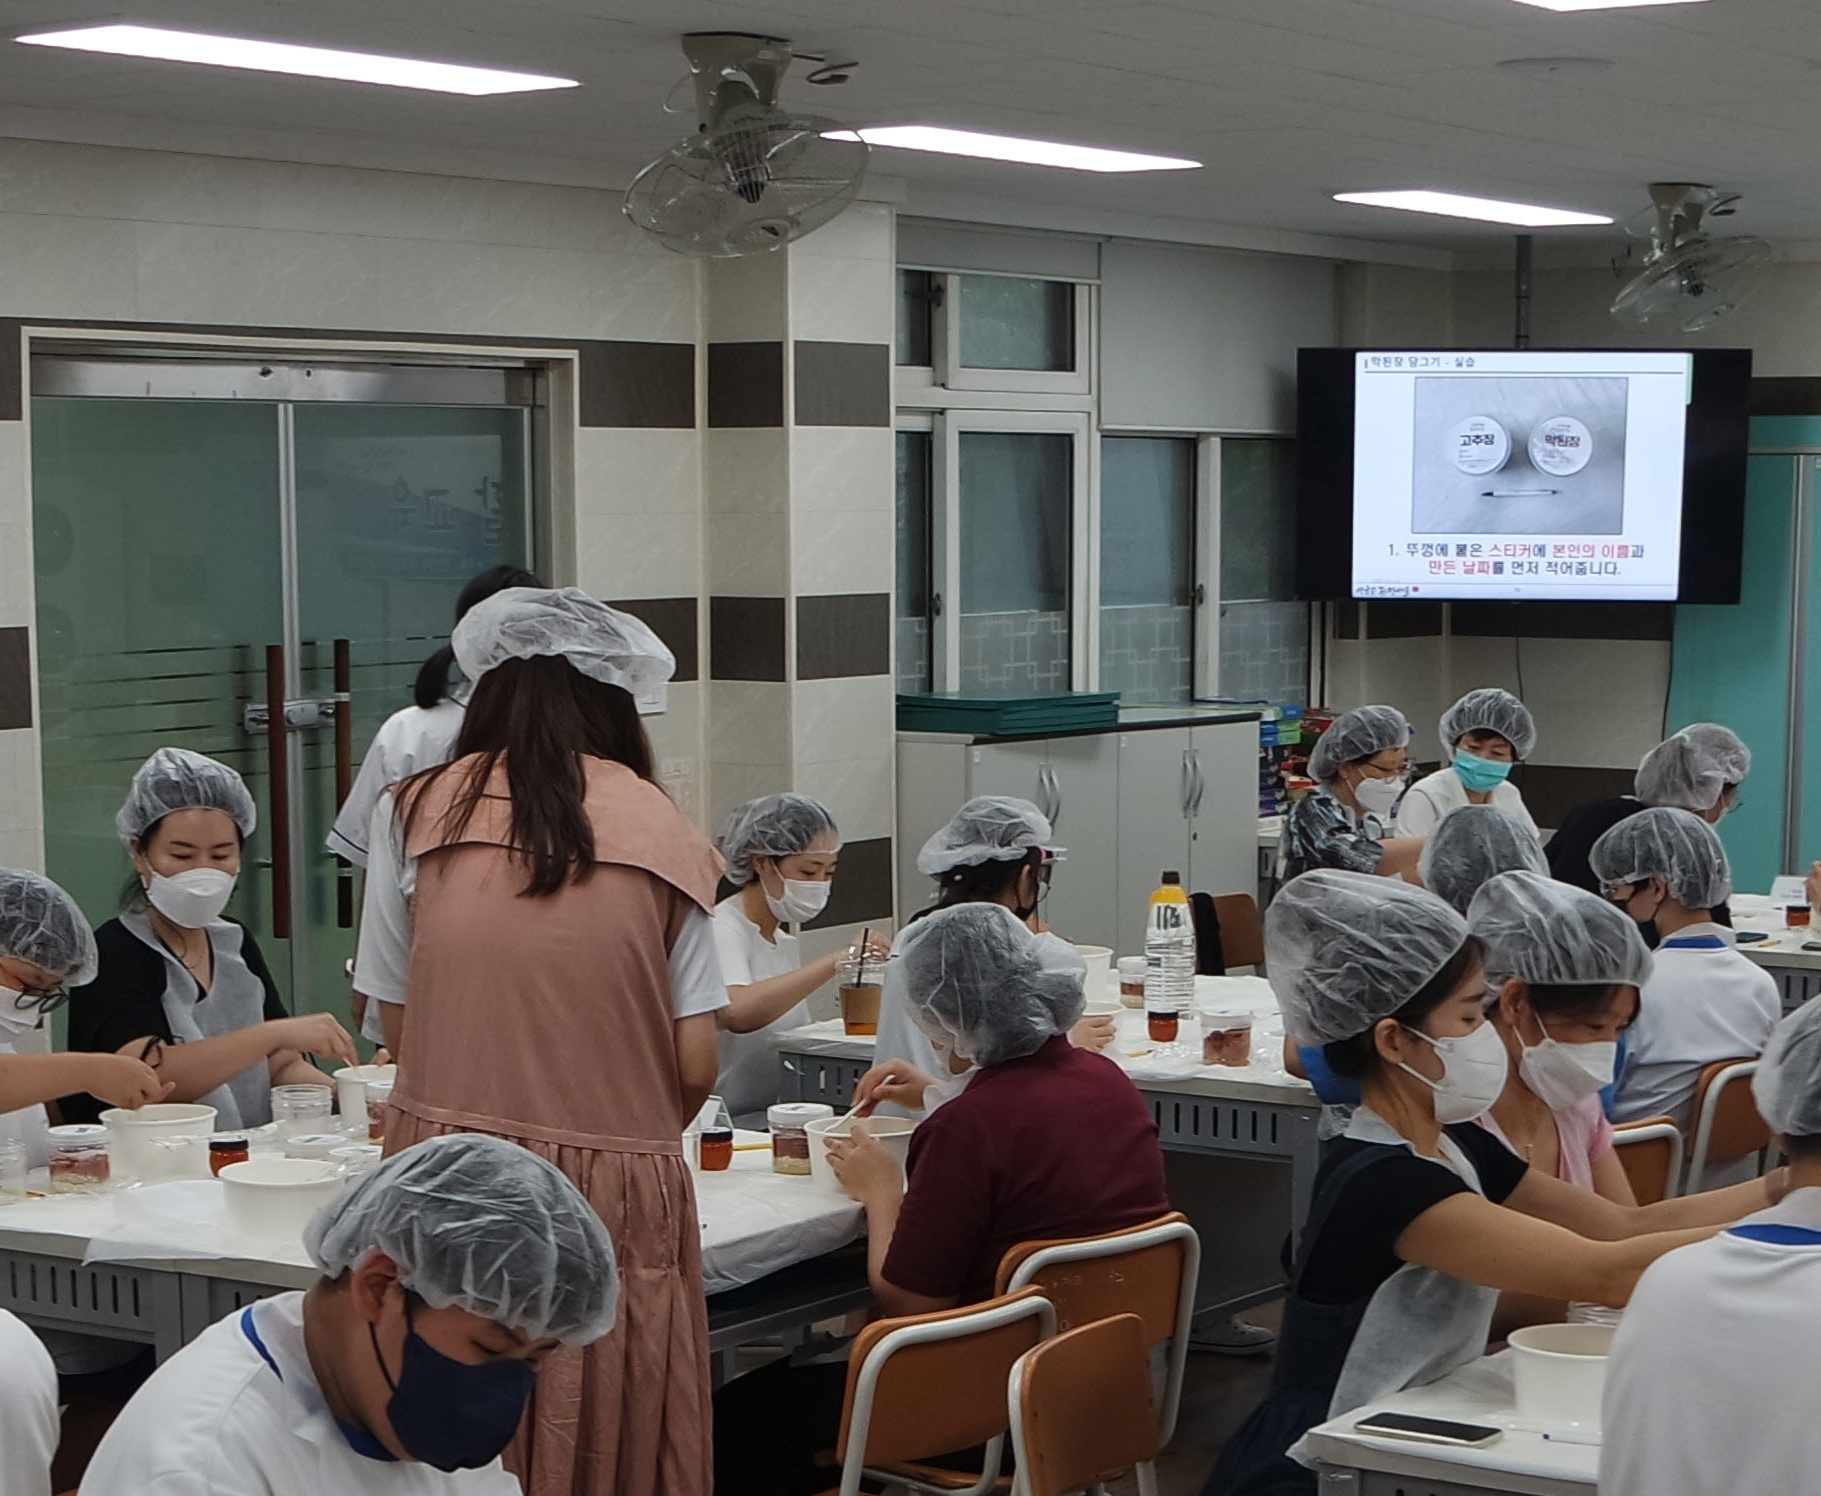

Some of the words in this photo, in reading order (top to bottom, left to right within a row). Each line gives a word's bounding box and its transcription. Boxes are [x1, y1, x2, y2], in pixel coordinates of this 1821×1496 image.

[1459, 433, 1495, 447] 고추장
[1388, 543, 1399, 556] 1.
[1406, 543, 1449, 558] 뚜껑에
[1488, 543, 1546, 558] 스티커에
[1552, 543, 1595, 559] 본인의
[1601, 544, 1645, 559] 이름과
[1428, 560, 1457, 576] 만든
[1510, 561, 1540, 576] 먼저
[1544, 561, 1622, 577] 적어줍니다.
